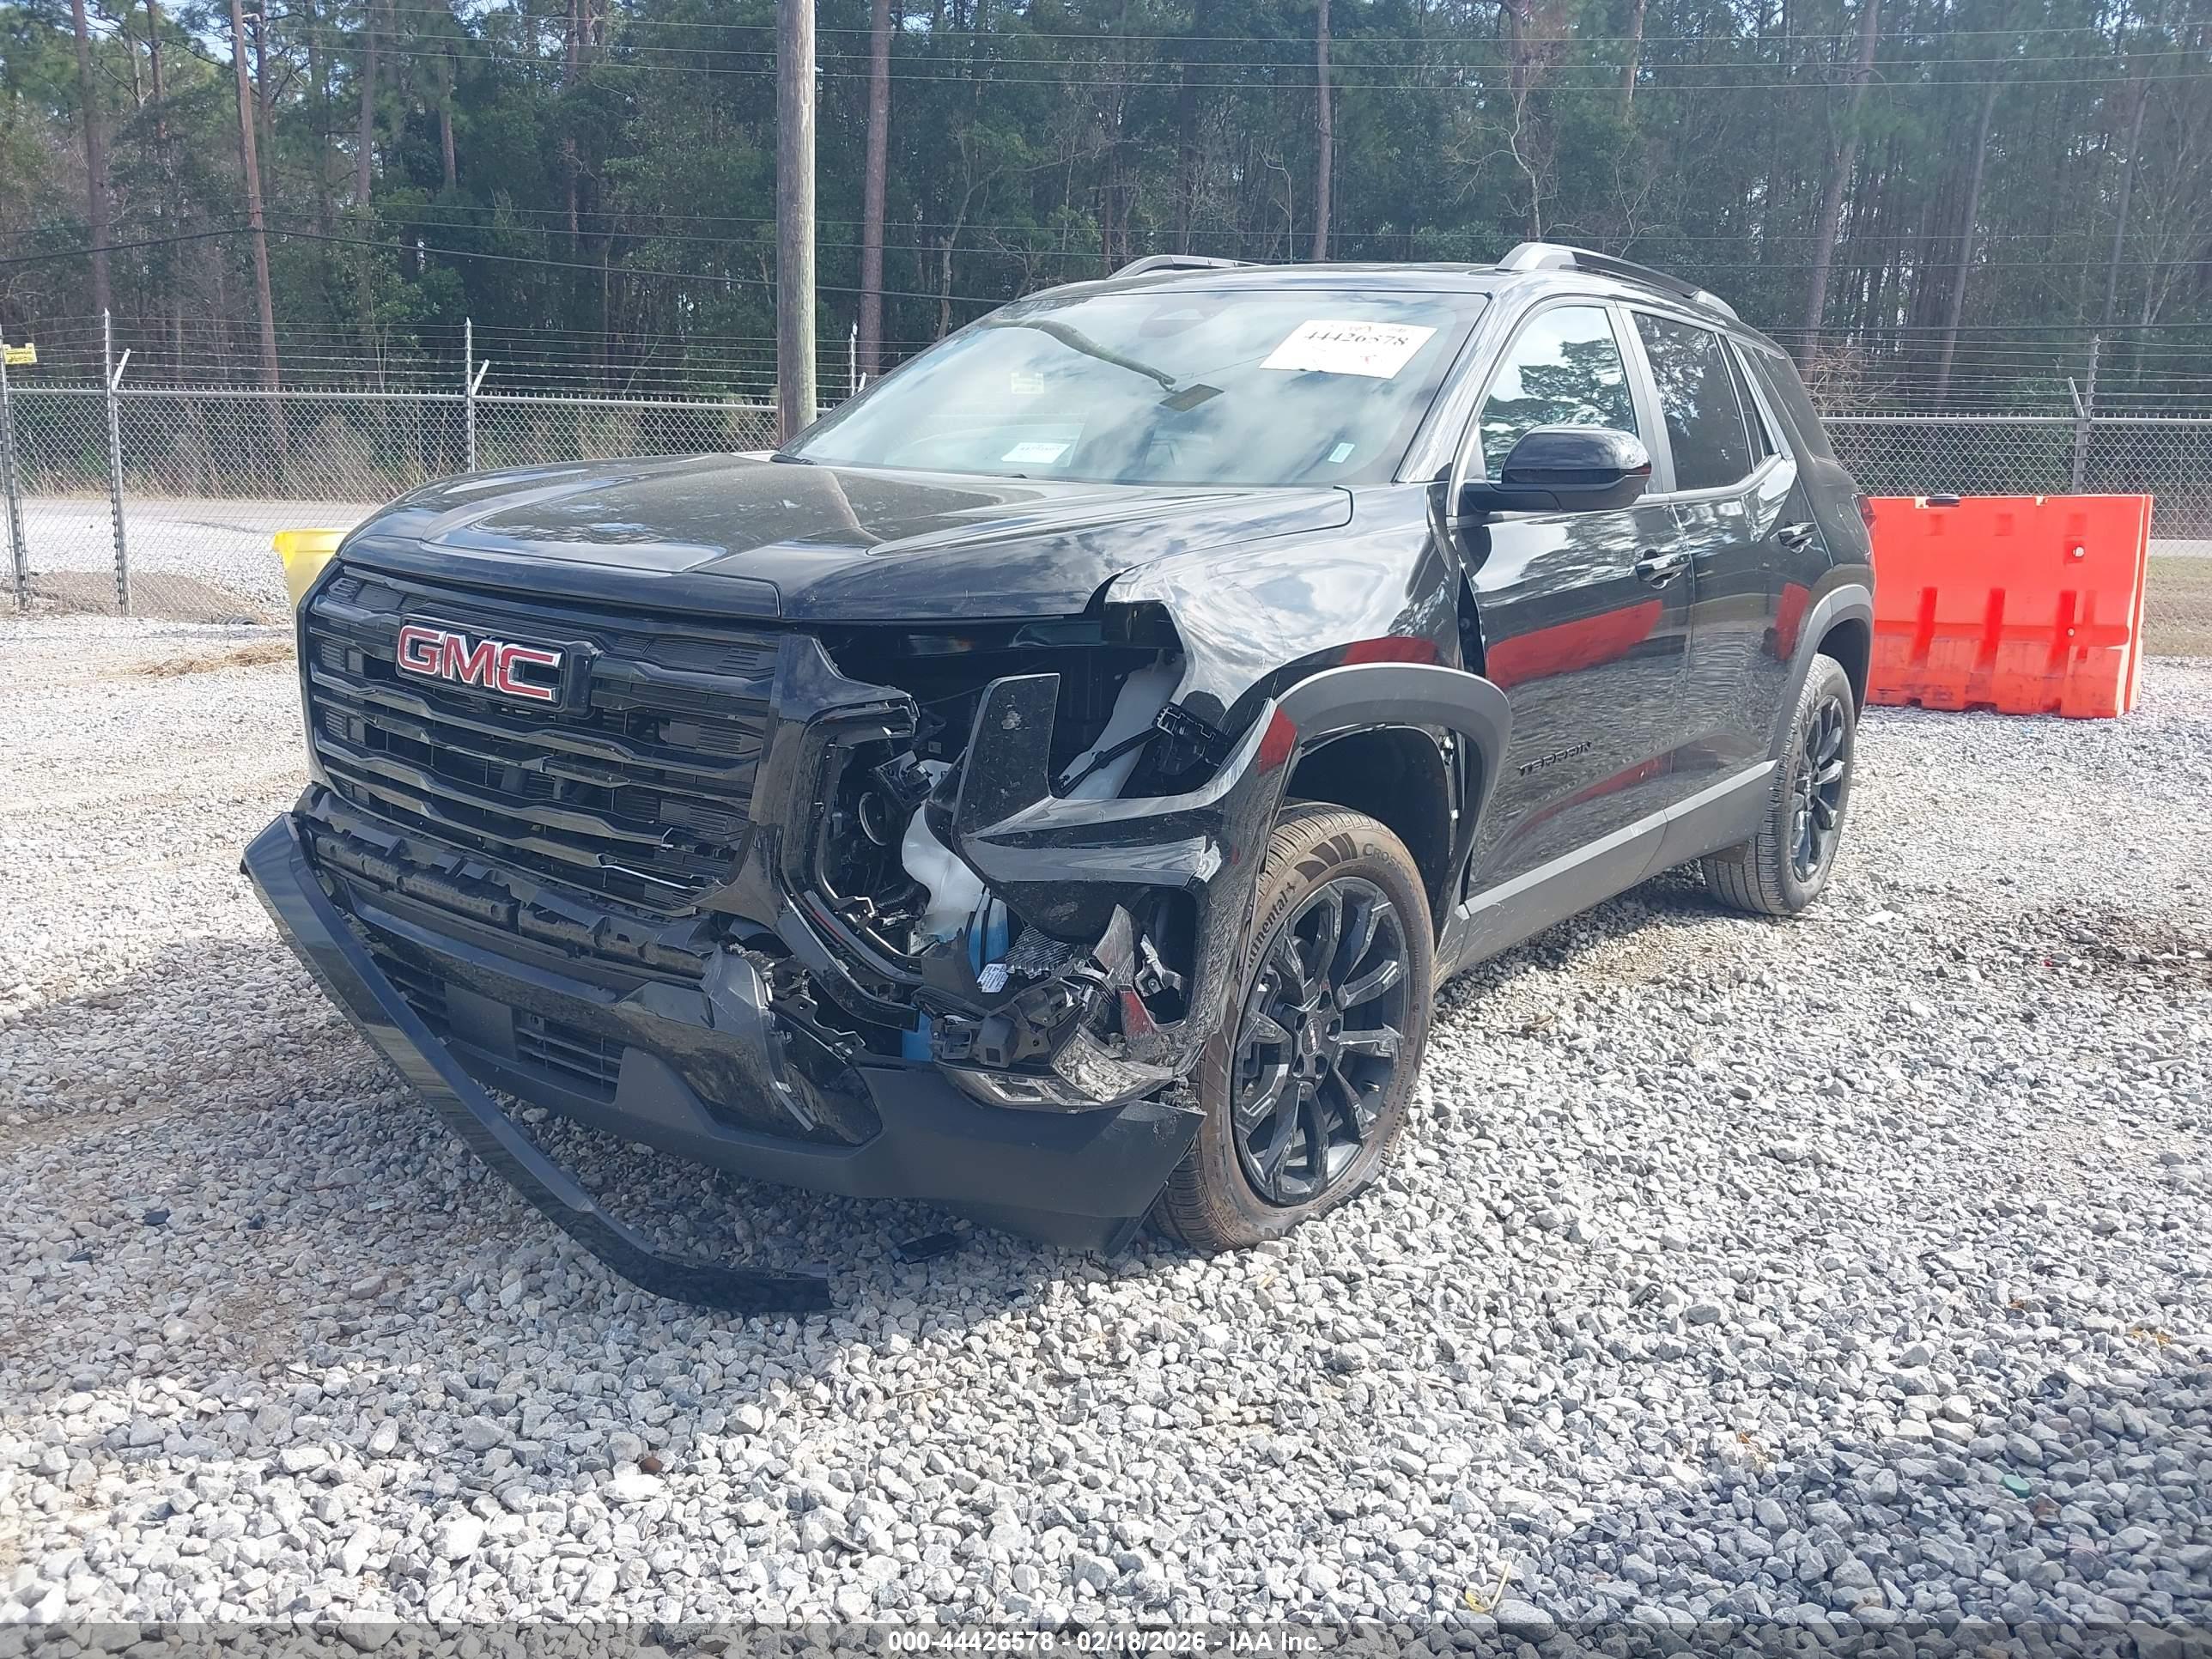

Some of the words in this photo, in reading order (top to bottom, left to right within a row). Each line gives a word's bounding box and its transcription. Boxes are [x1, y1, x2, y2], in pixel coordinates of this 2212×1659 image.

[1304, 331, 1409, 346] 44426578
[398, 625, 562, 702] GMC
[1517, 740, 1592, 776] TERRAIN
